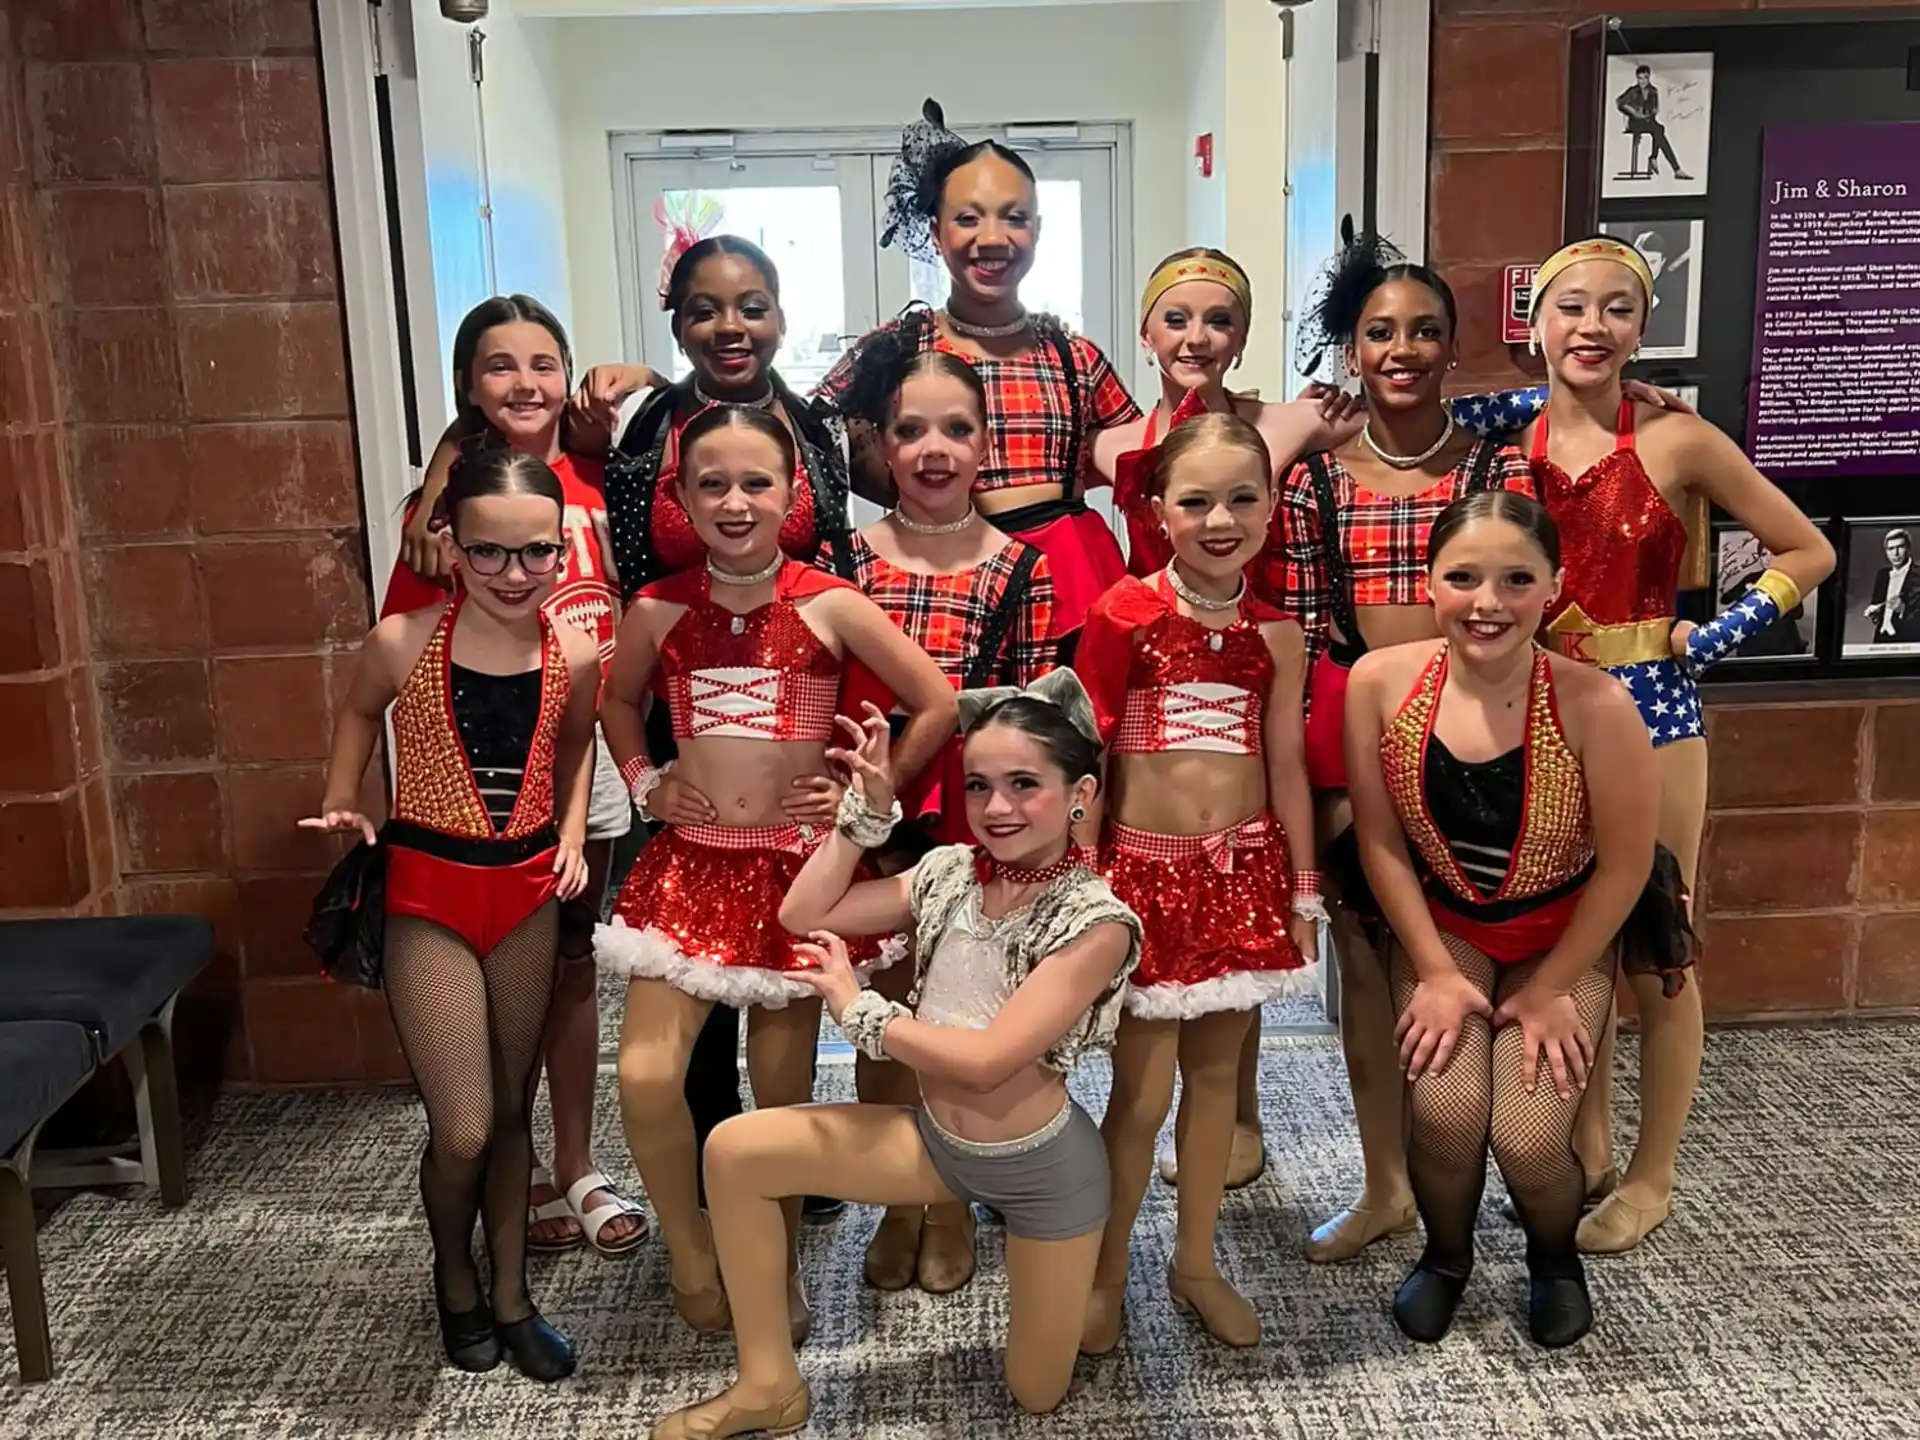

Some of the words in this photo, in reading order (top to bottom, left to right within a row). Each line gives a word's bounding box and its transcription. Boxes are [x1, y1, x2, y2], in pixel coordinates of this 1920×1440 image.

[1770, 181, 1808, 204] Jim
[1815, 179, 1830, 198] &
[1837, 178, 1907, 198] Sharon
